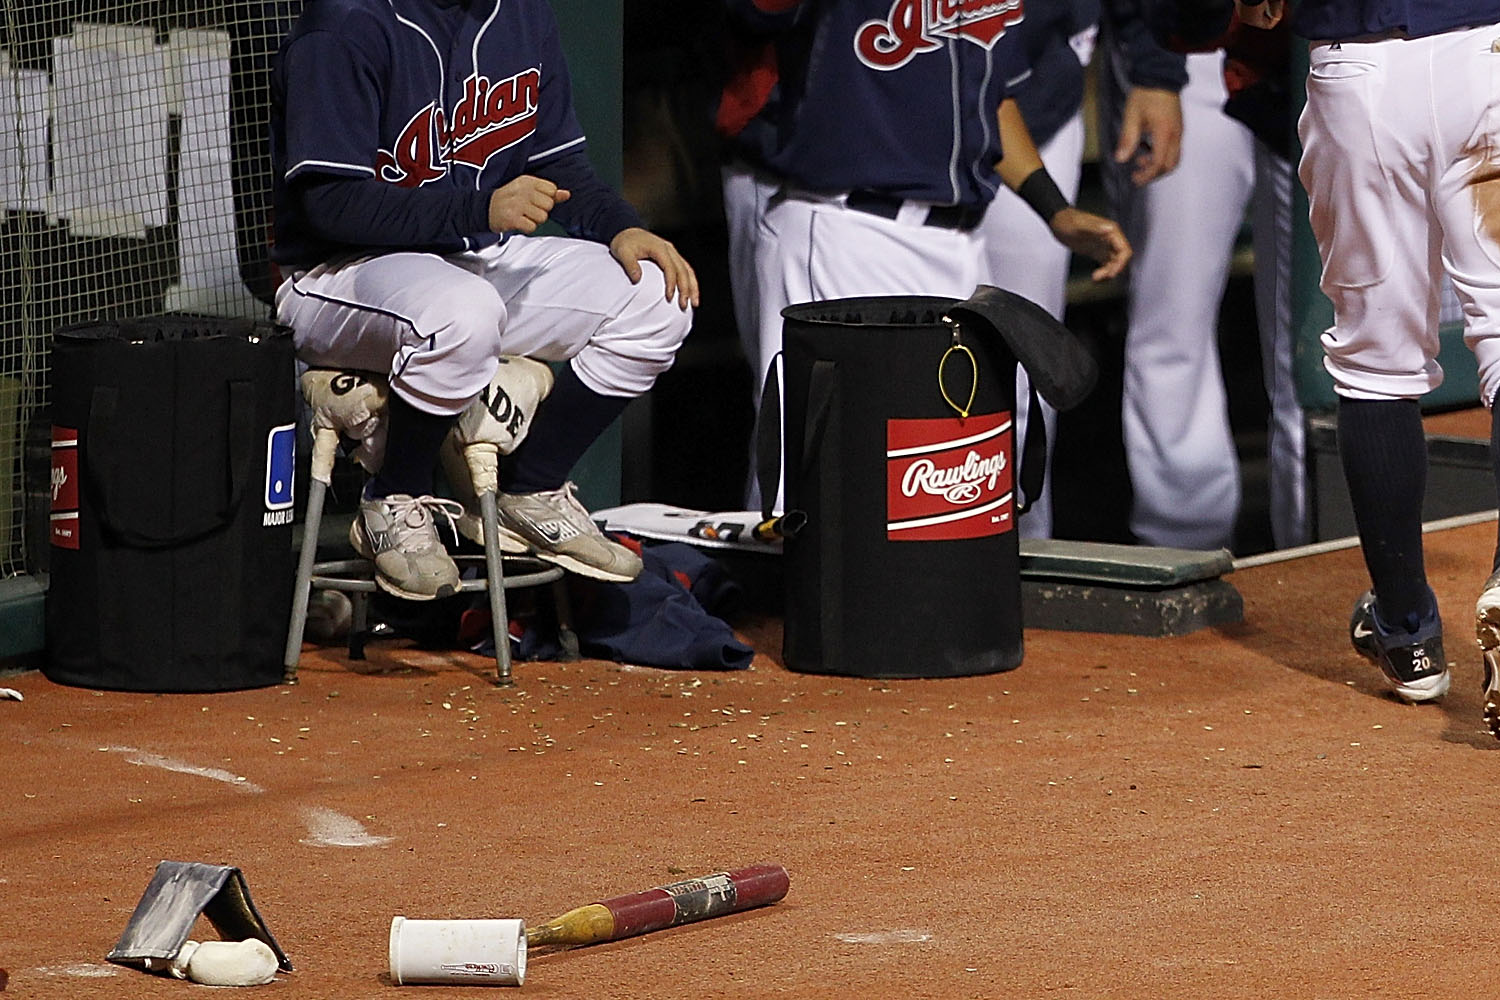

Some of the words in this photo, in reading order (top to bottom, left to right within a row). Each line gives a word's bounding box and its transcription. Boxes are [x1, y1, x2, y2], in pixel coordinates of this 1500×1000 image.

[901, 450, 1007, 497] Rawlings
[262, 511, 285, 528] MAJOR
[1412, 657, 1431, 672] 20
